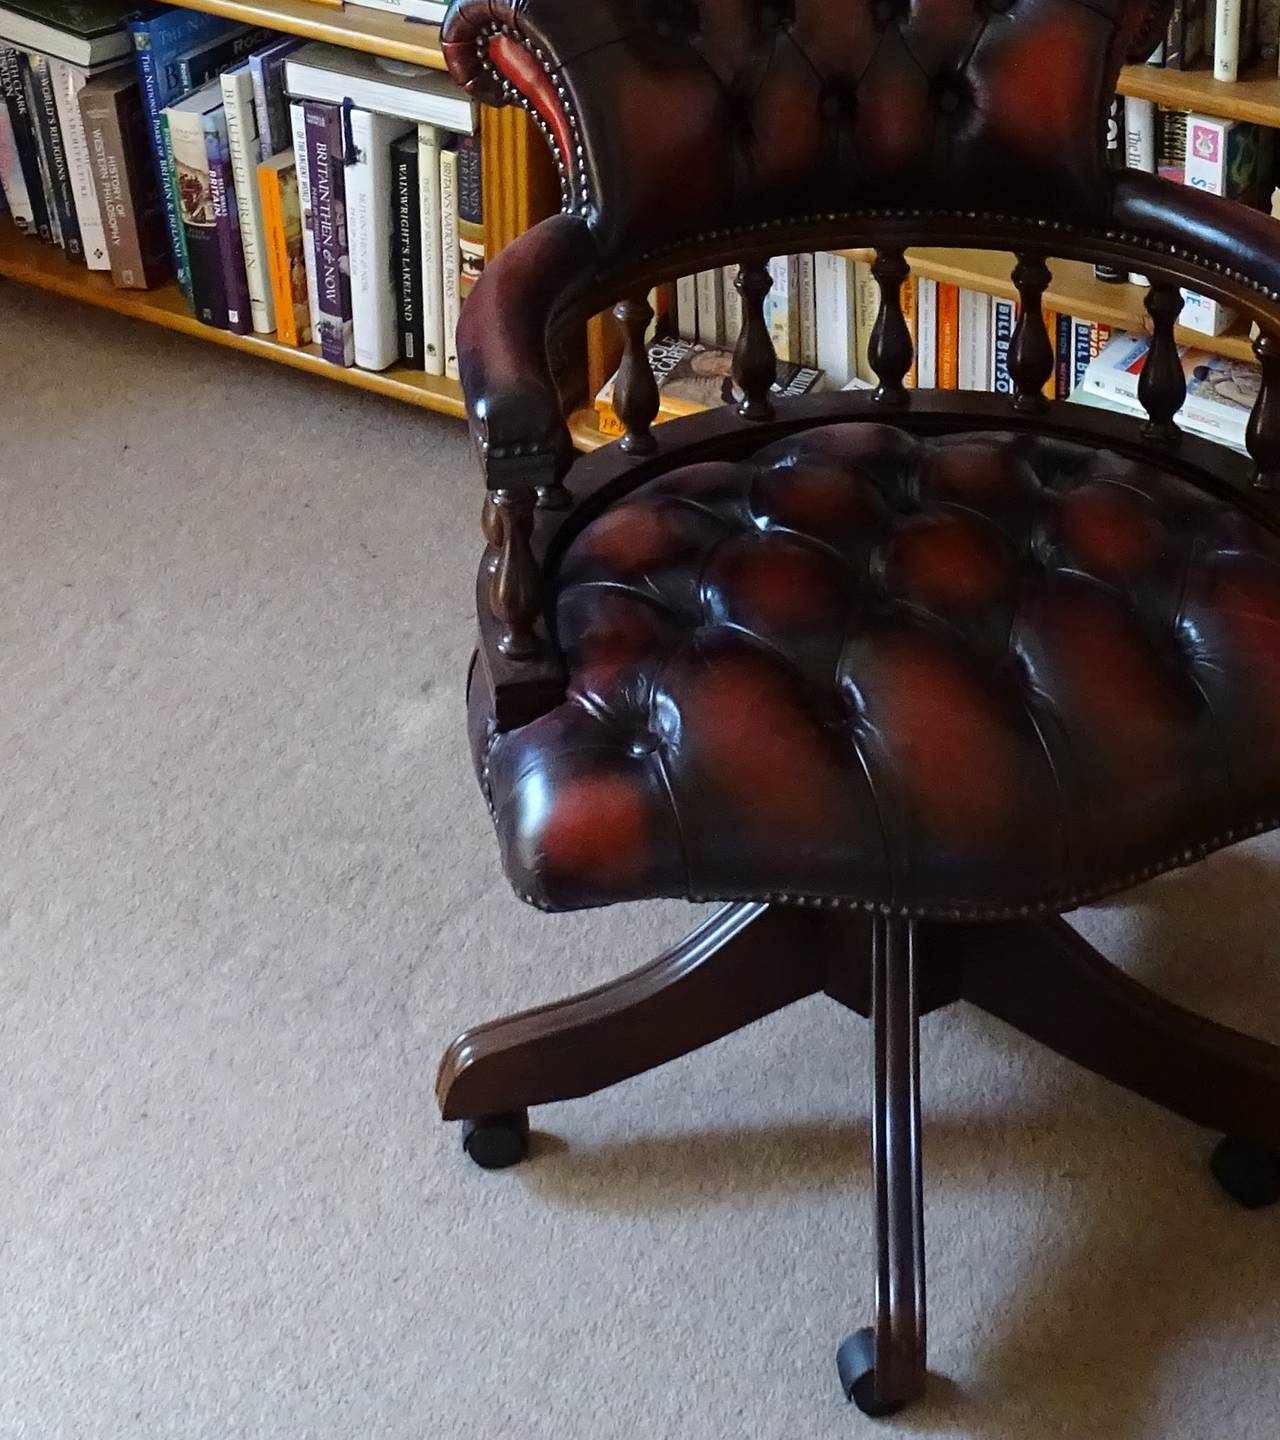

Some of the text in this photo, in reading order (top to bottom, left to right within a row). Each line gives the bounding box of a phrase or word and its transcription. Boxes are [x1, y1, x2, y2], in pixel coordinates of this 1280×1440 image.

[49, 126, 66, 181] RELIGIONS
[145, 74, 173, 200] NATIONAL BRITAIN
[224, 89, 257, 270] BEAUTIFUL BRITAIN
[460, 148, 471, 210] HERITAGE
[208, 169, 221, 218] BRITAIN
[314, 142, 338, 304] BRITAIN THEN NOW
[398, 163, 414, 322] WAINWRIGHT'S LAKELAND
[997, 304, 1011, 337] BILL
